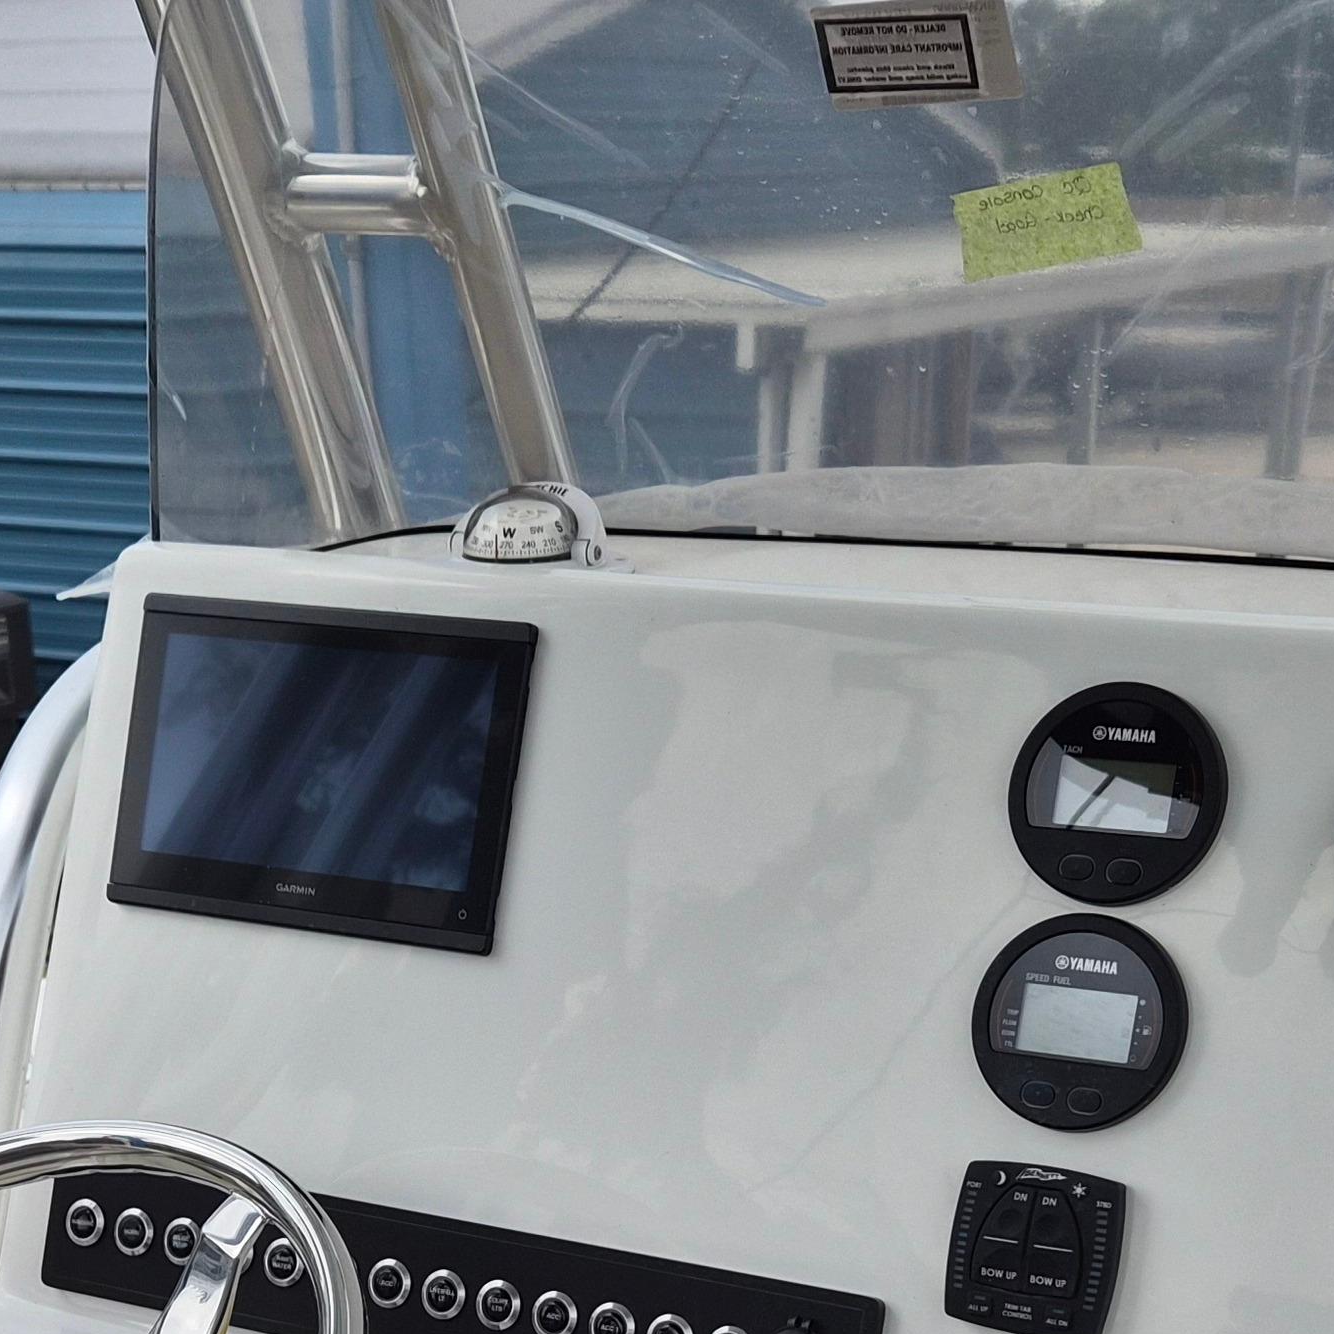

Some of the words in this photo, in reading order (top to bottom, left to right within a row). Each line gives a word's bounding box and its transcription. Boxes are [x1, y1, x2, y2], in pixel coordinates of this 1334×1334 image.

[502, 527, 516, 539] W
[499, 541, 514, 549] 270
[521, 541, 536, 549] 240
[543, 538, 557, 547] 210
[1107, 726, 1156, 744] YAMAHA
[276, 883, 316, 896] GARMIN
[1069, 956, 1118, 976] YAMAHA
[1025, 972, 1050, 983] SPEED
[1053, 975, 1071, 986] FUEL
[966, 1181, 982, 1189] PORT
[1014, 1192, 1028, 1202] DN
[1042, 1197, 1057, 1207] DN
[980, 1267, 1003, 1279] BOW
[1005, 1271, 1017, 1280] UP
[1029, 1275, 1053, 1287] BOW
[1055, 1279, 1067, 1288] UP
